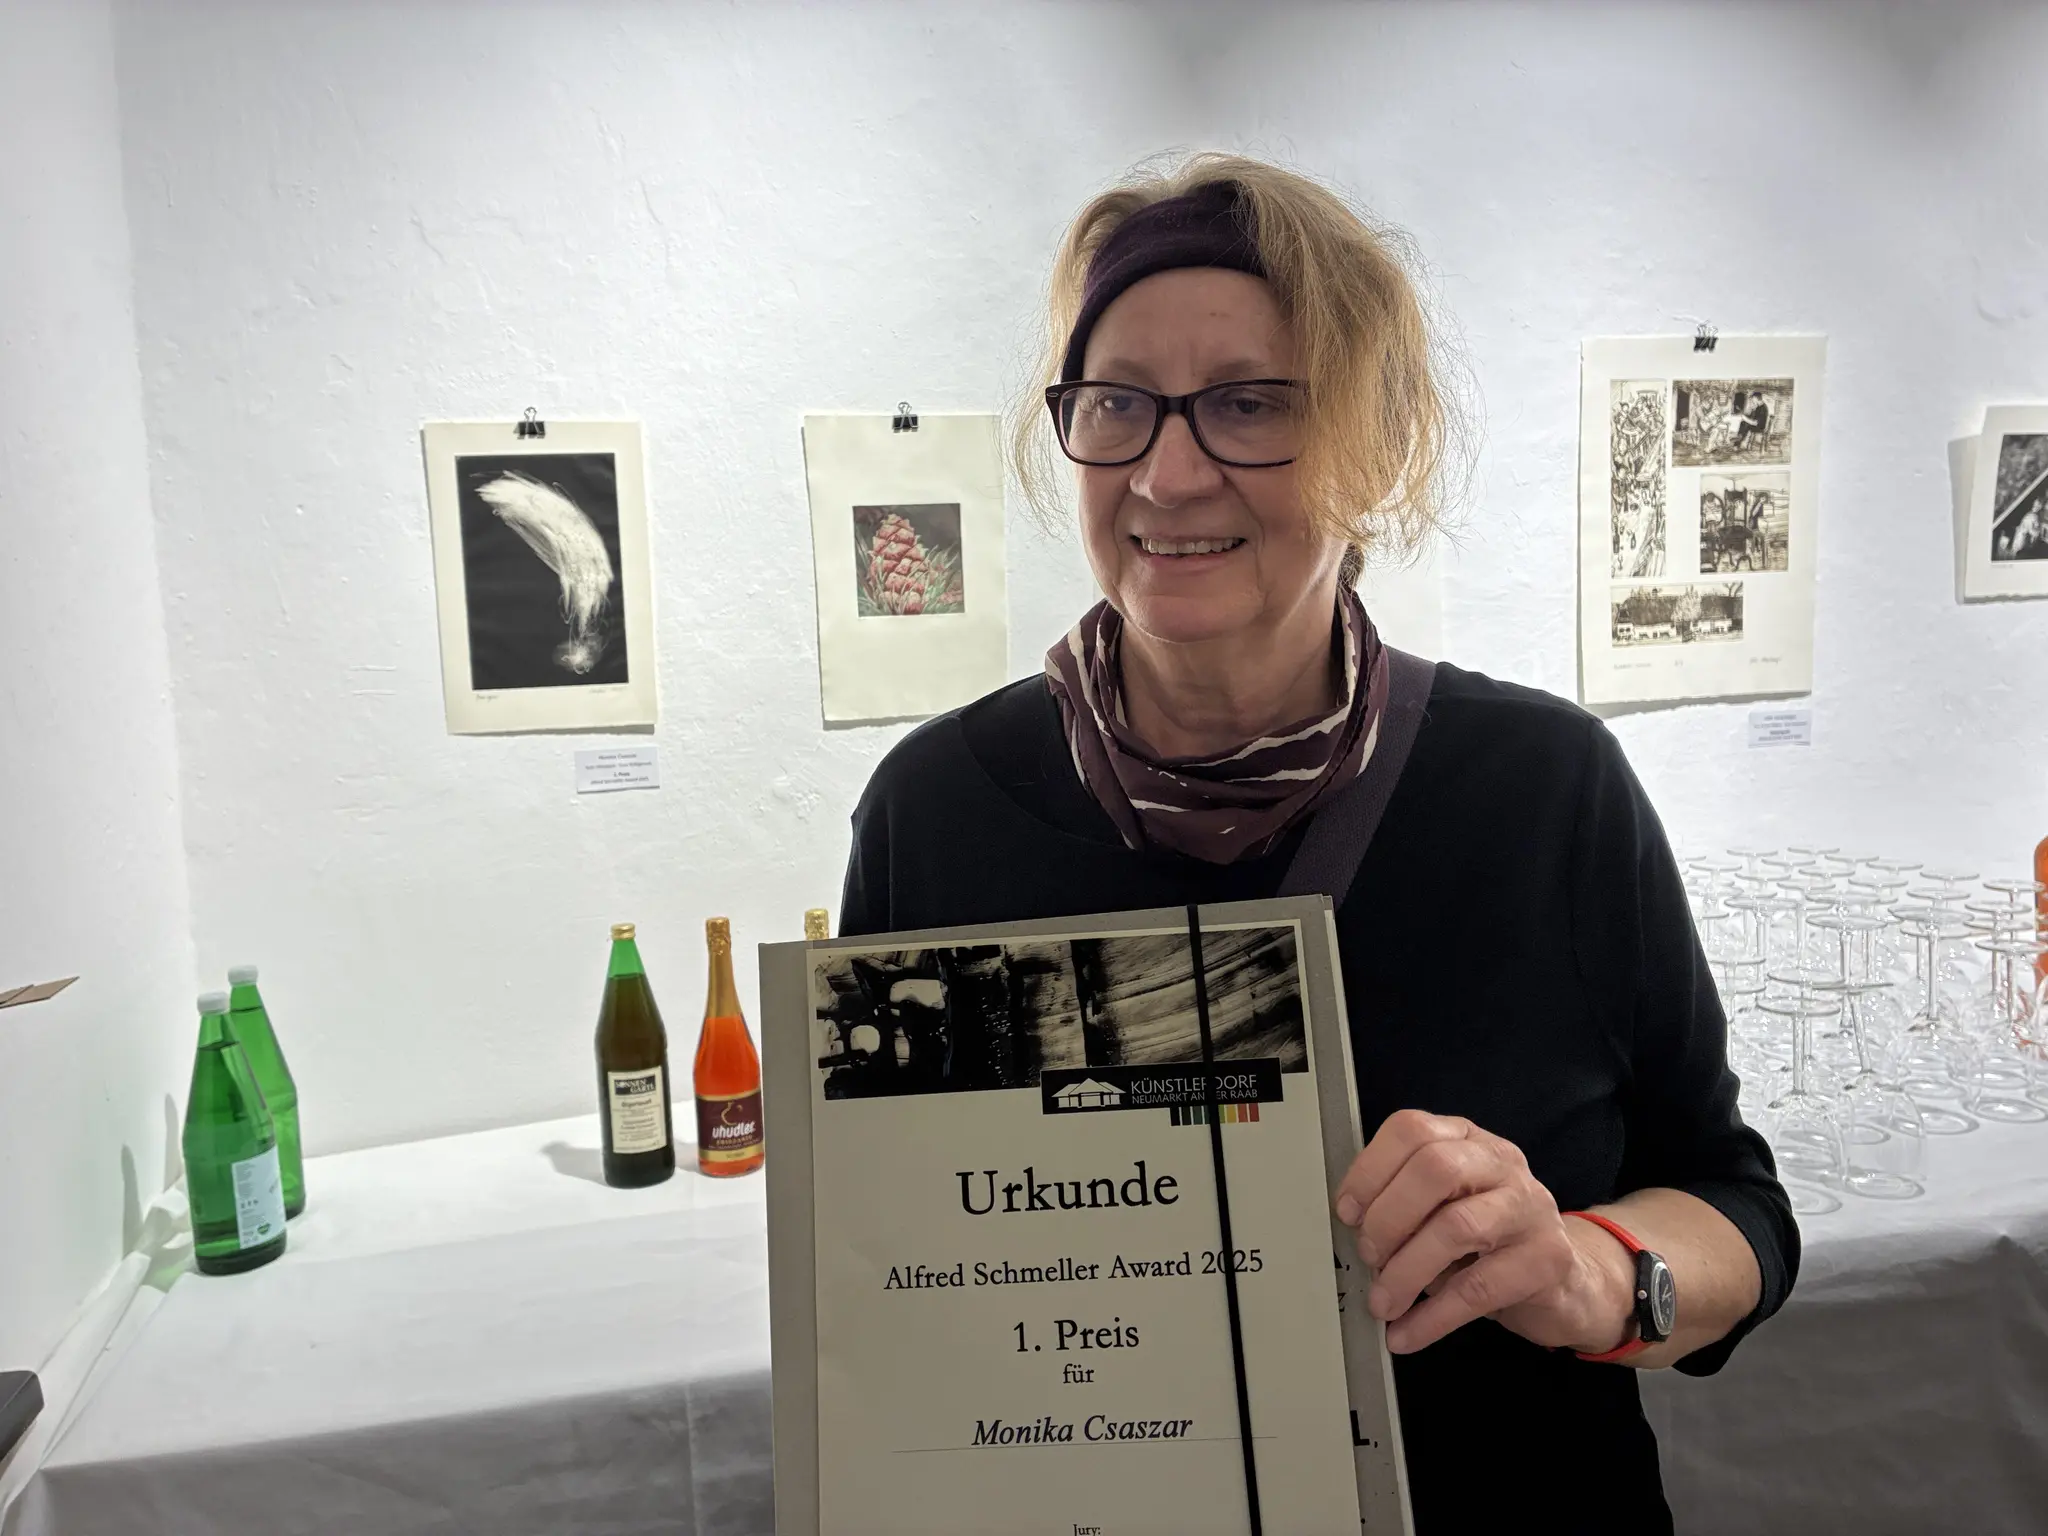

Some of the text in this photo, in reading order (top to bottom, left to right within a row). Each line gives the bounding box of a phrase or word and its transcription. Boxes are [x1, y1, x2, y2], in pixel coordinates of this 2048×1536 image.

[1132, 1093, 1187, 1105] NEUMARKT
[1191, 1092, 1205, 1102] AN
[1230, 1089, 1258, 1099] RAAB
[956, 1161, 1179, 1216] Urkunde
[884, 1263, 966, 1290] Alfred
[975, 1258, 1100, 1286] Schmeller
[1108, 1252, 1193, 1279] Award
[1014, 1317, 1140, 1353] 1. Preis
[1063, 1364, 1095, 1384] für
[971, 1415, 1193, 1446] Monika Csaszar
[1073, 1523, 1101, 1536] Jury:
